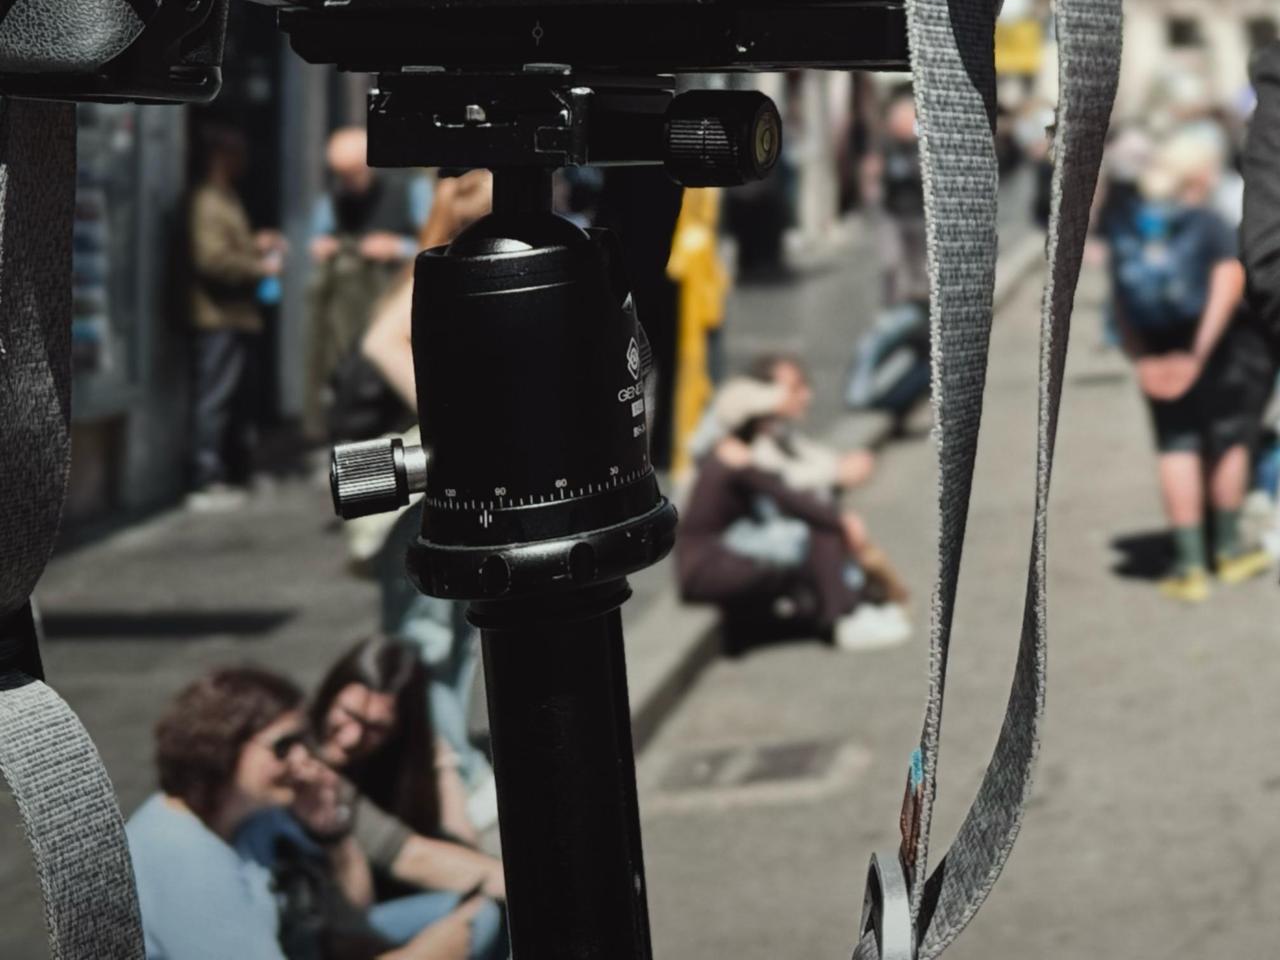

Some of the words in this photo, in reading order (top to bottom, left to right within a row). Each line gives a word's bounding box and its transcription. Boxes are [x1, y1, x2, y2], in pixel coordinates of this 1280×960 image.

[494, 487, 507, 497] 90
[555, 478, 568, 488] 60
[609, 465, 620, 476] 30
